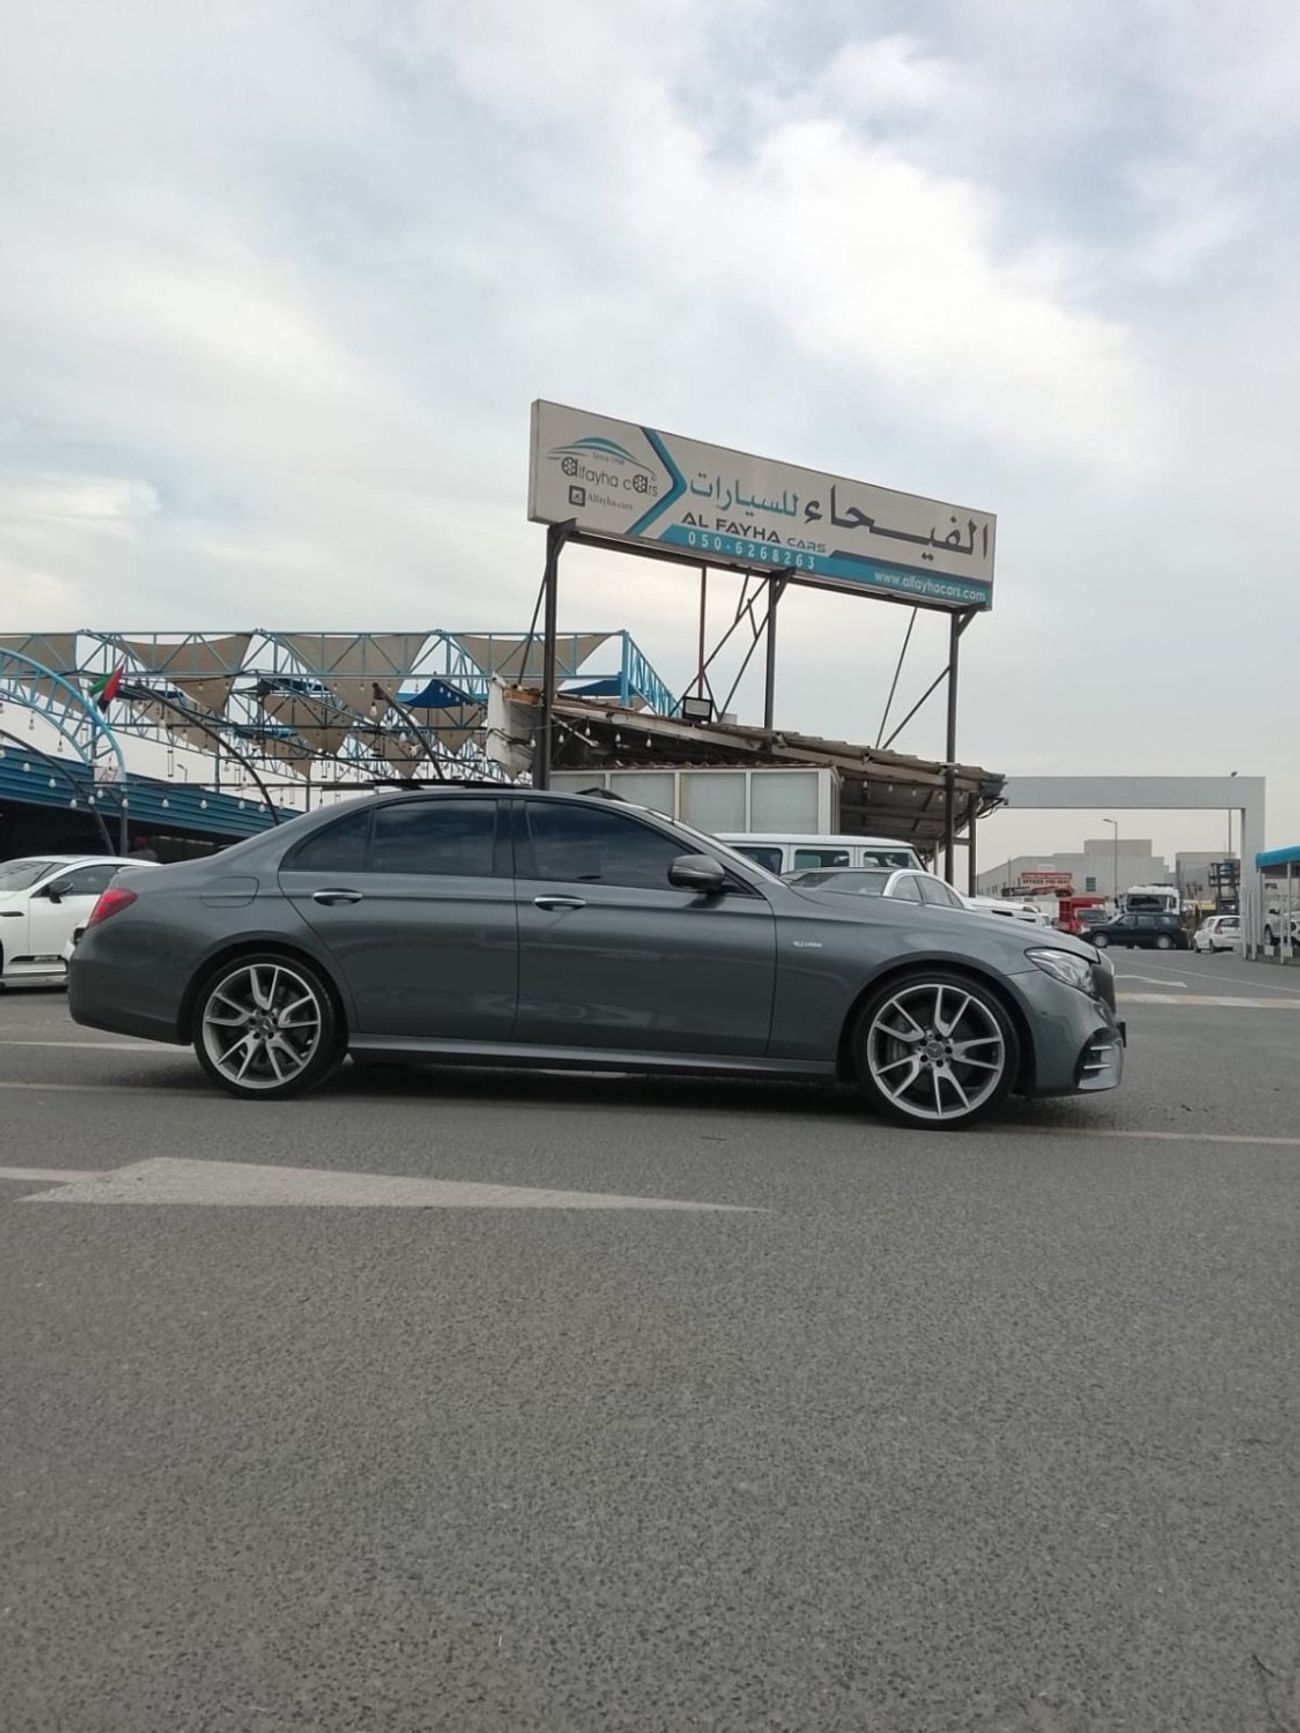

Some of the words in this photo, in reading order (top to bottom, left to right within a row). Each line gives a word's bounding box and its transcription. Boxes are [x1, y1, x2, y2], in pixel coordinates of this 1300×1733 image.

[561, 456, 619, 488] alfayha
[622, 474, 658, 497] cars
[690, 472, 799, 517] للسيارات
[681, 511, 709, 528] AL
[716, 518, 781, 543] FAYHA
[786, 537, 827, 553] CARS
[804, 484, 989, 562] الفيحاء
[874, 571, 986, 601] www.alfayhacars.com
